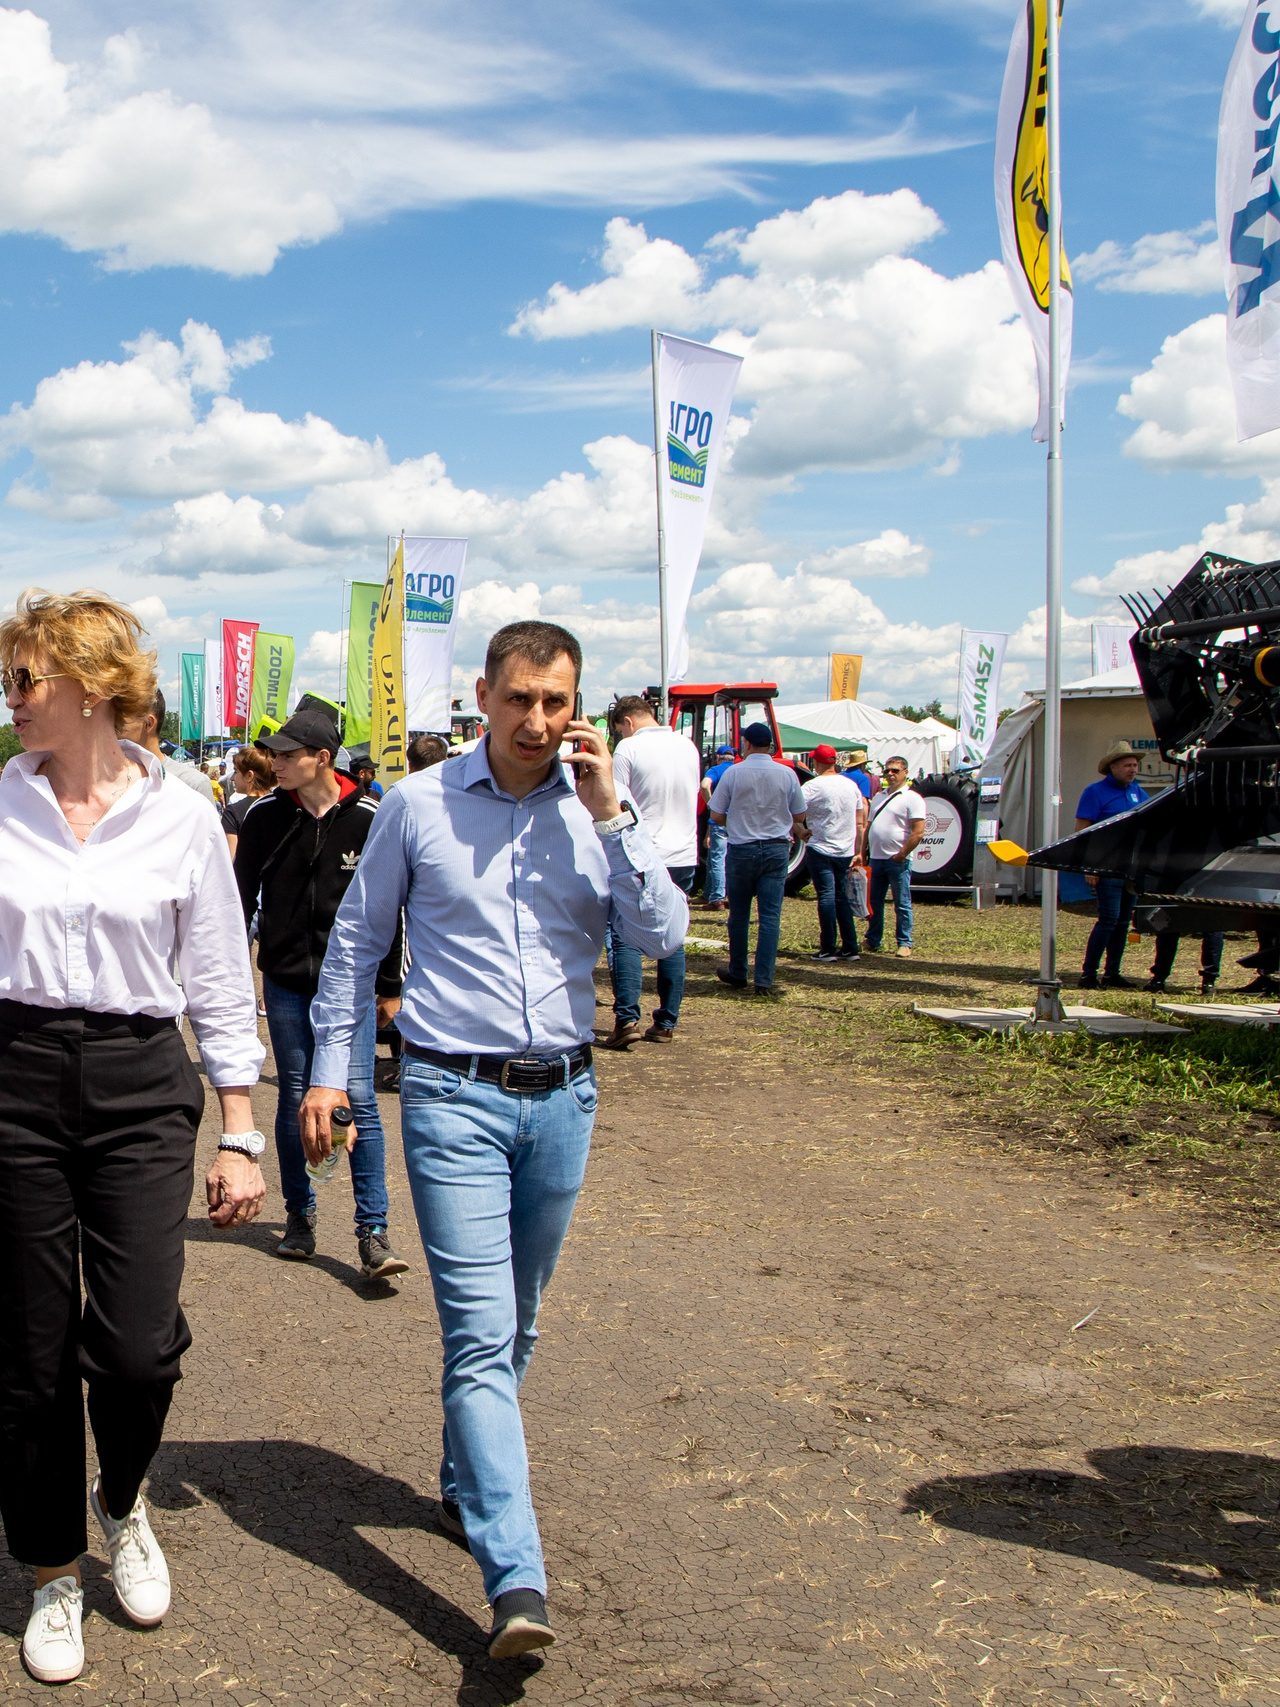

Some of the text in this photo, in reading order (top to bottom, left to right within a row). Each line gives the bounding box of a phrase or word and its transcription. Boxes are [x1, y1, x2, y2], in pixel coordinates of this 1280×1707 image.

[405, 573, 455, 599] АГРО
[235, 632, 253, 719] HORSCH
[970, 645, 994, 742] SaMASZ
